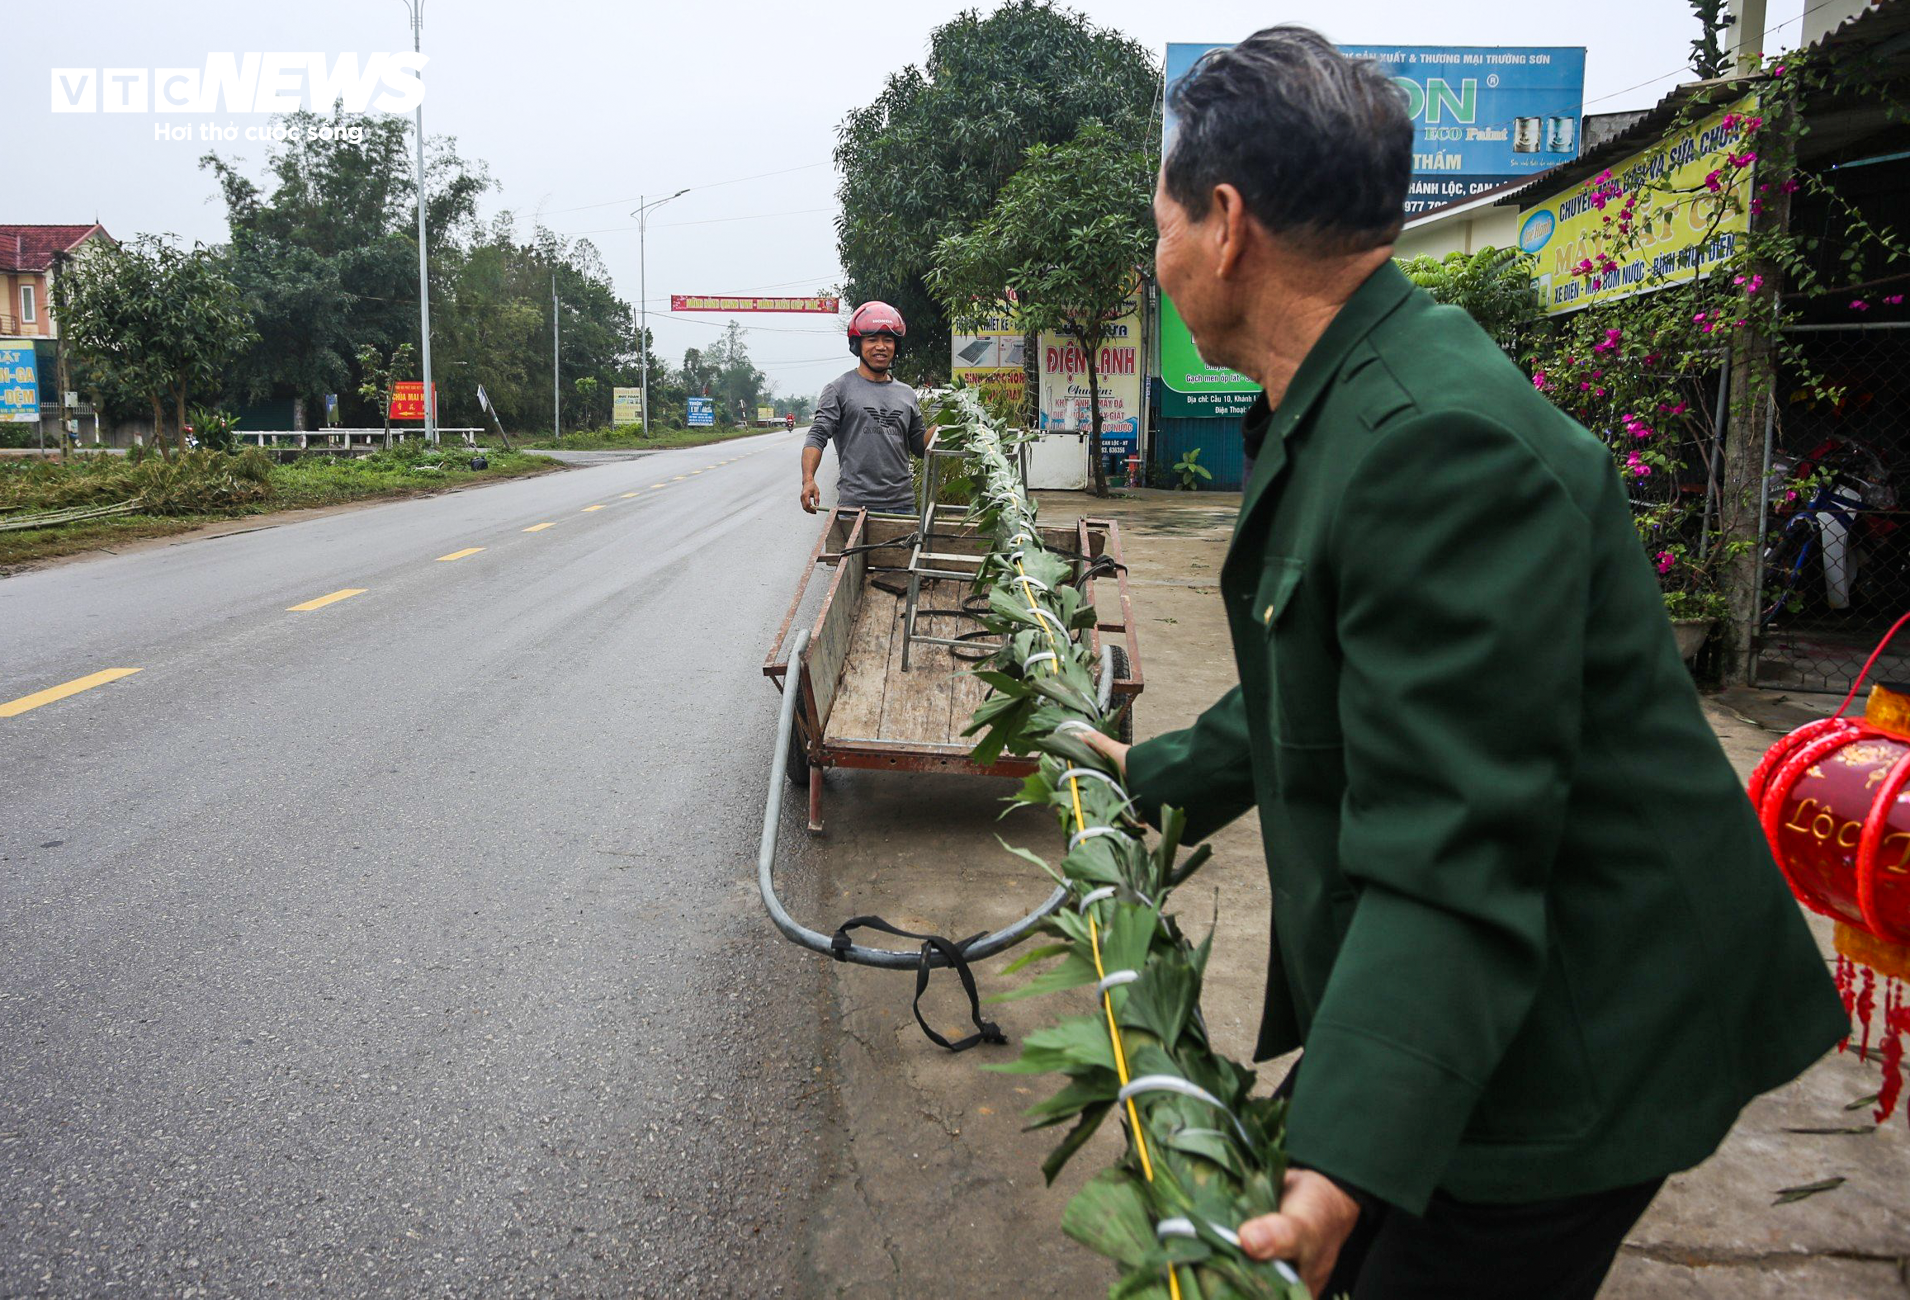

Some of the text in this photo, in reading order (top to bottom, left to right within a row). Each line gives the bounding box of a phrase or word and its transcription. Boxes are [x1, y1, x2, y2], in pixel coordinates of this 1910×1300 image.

[1379, 50, 1406, 63] XUẤT
[1409, 53, 1417, 63] &
[1420, 53, 1460, 64] THƯƠNG
[1463, 53, 1483, 66] MẠI
[1486, 52, 1527, 64] TRƯỜNG
[1529, 53, 1551, 64] SƠN
[1424, 127, 1508, 141] ECO Paint
[1412, 149, 1462, 170] THẤM
[1408, 181, 1439, 194] HÁNH
[1442, 181, 1466, 197] LỘC,
[1404, 201, 1426, 212] 977
[1555, 286, 1562, 303] XE
[1564, 279, 1579, 303] ĐIỆN
[1622, 258, 1645, 285] NƯỚC
[1046, 340, 1087, 383] ĐIỆN
[1186, 374, 1203, 384] Gạch
[1187, 395, 1196, 404] Địa
[1210, 394, 1221, 403] Cầu
[1224, 395, 1232, 404] 10,
[1234, 395, 1252, 403] Khánh
